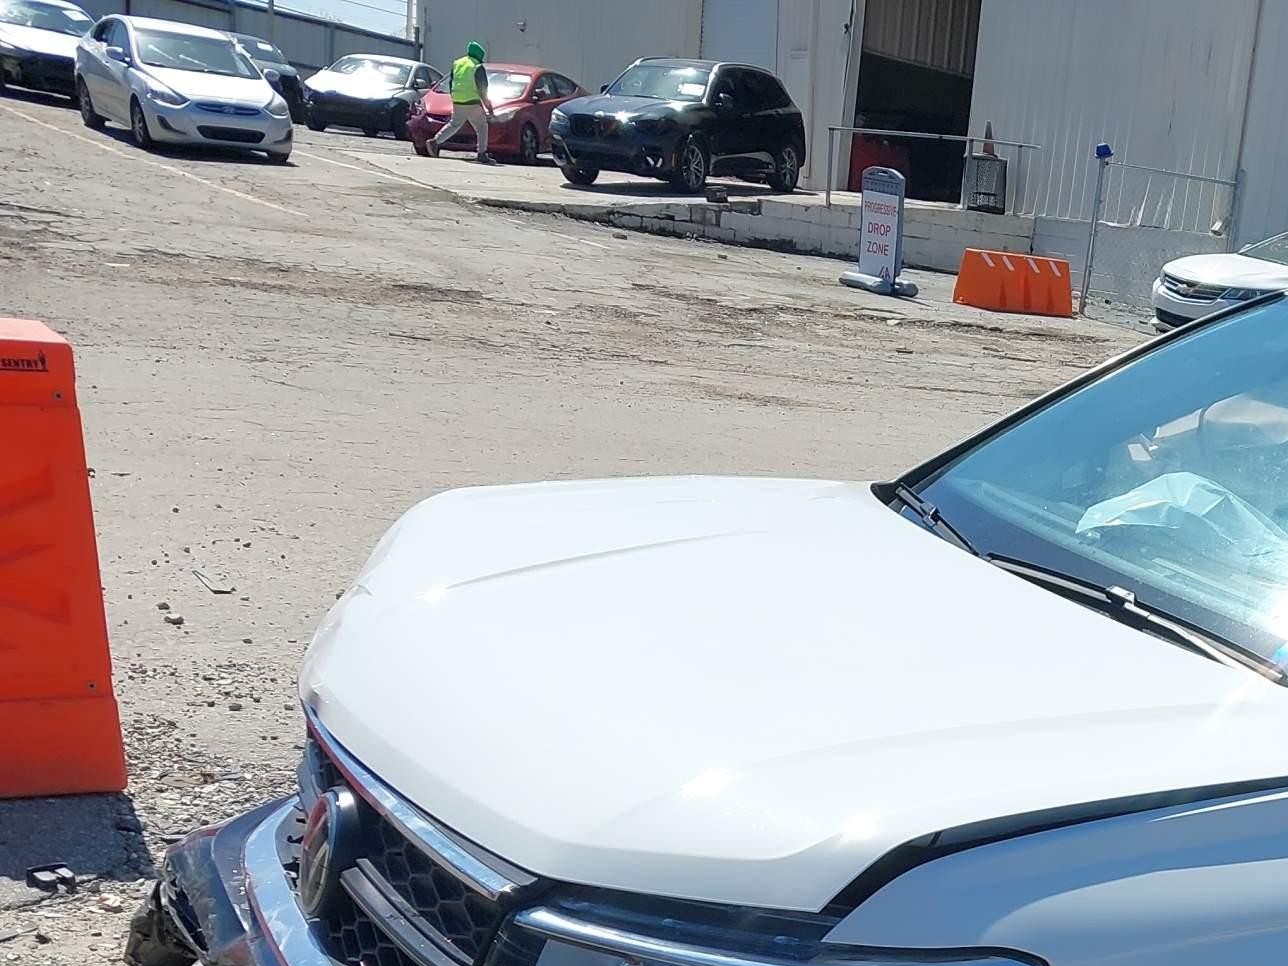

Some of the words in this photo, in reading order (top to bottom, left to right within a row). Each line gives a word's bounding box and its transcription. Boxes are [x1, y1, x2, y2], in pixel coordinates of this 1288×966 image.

[864, 200, 897, 217] PROGRESSIVE
[867, 222, 892, 237] DROP
[866, 240, 889, 257] ZONE
[0, 357, 38, 369] SENTRY
